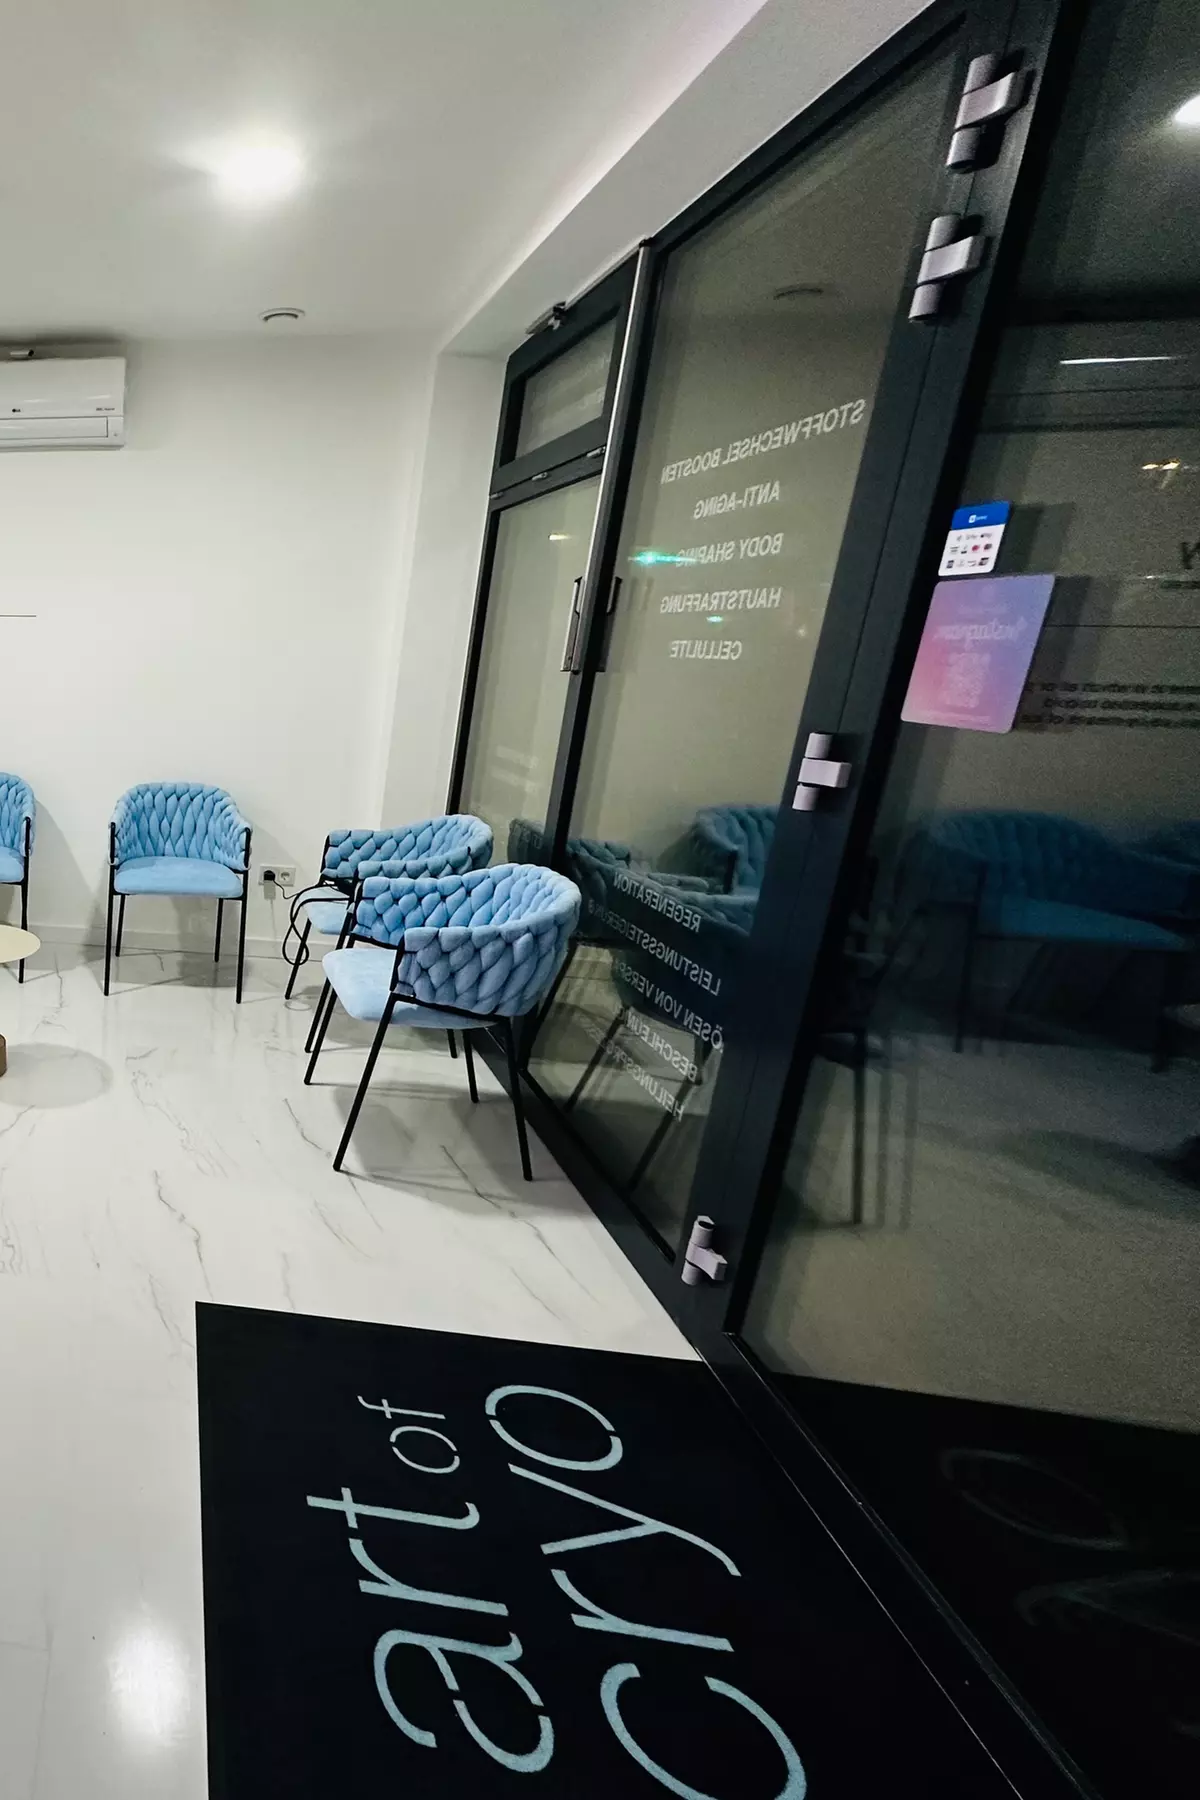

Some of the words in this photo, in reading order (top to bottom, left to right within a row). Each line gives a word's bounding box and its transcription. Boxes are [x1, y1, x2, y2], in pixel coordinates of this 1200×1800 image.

[357, 1396, 460, 1473] of
[306, 1486, 554, 1772] art
[484, 1384, 807, 1800] cryo
